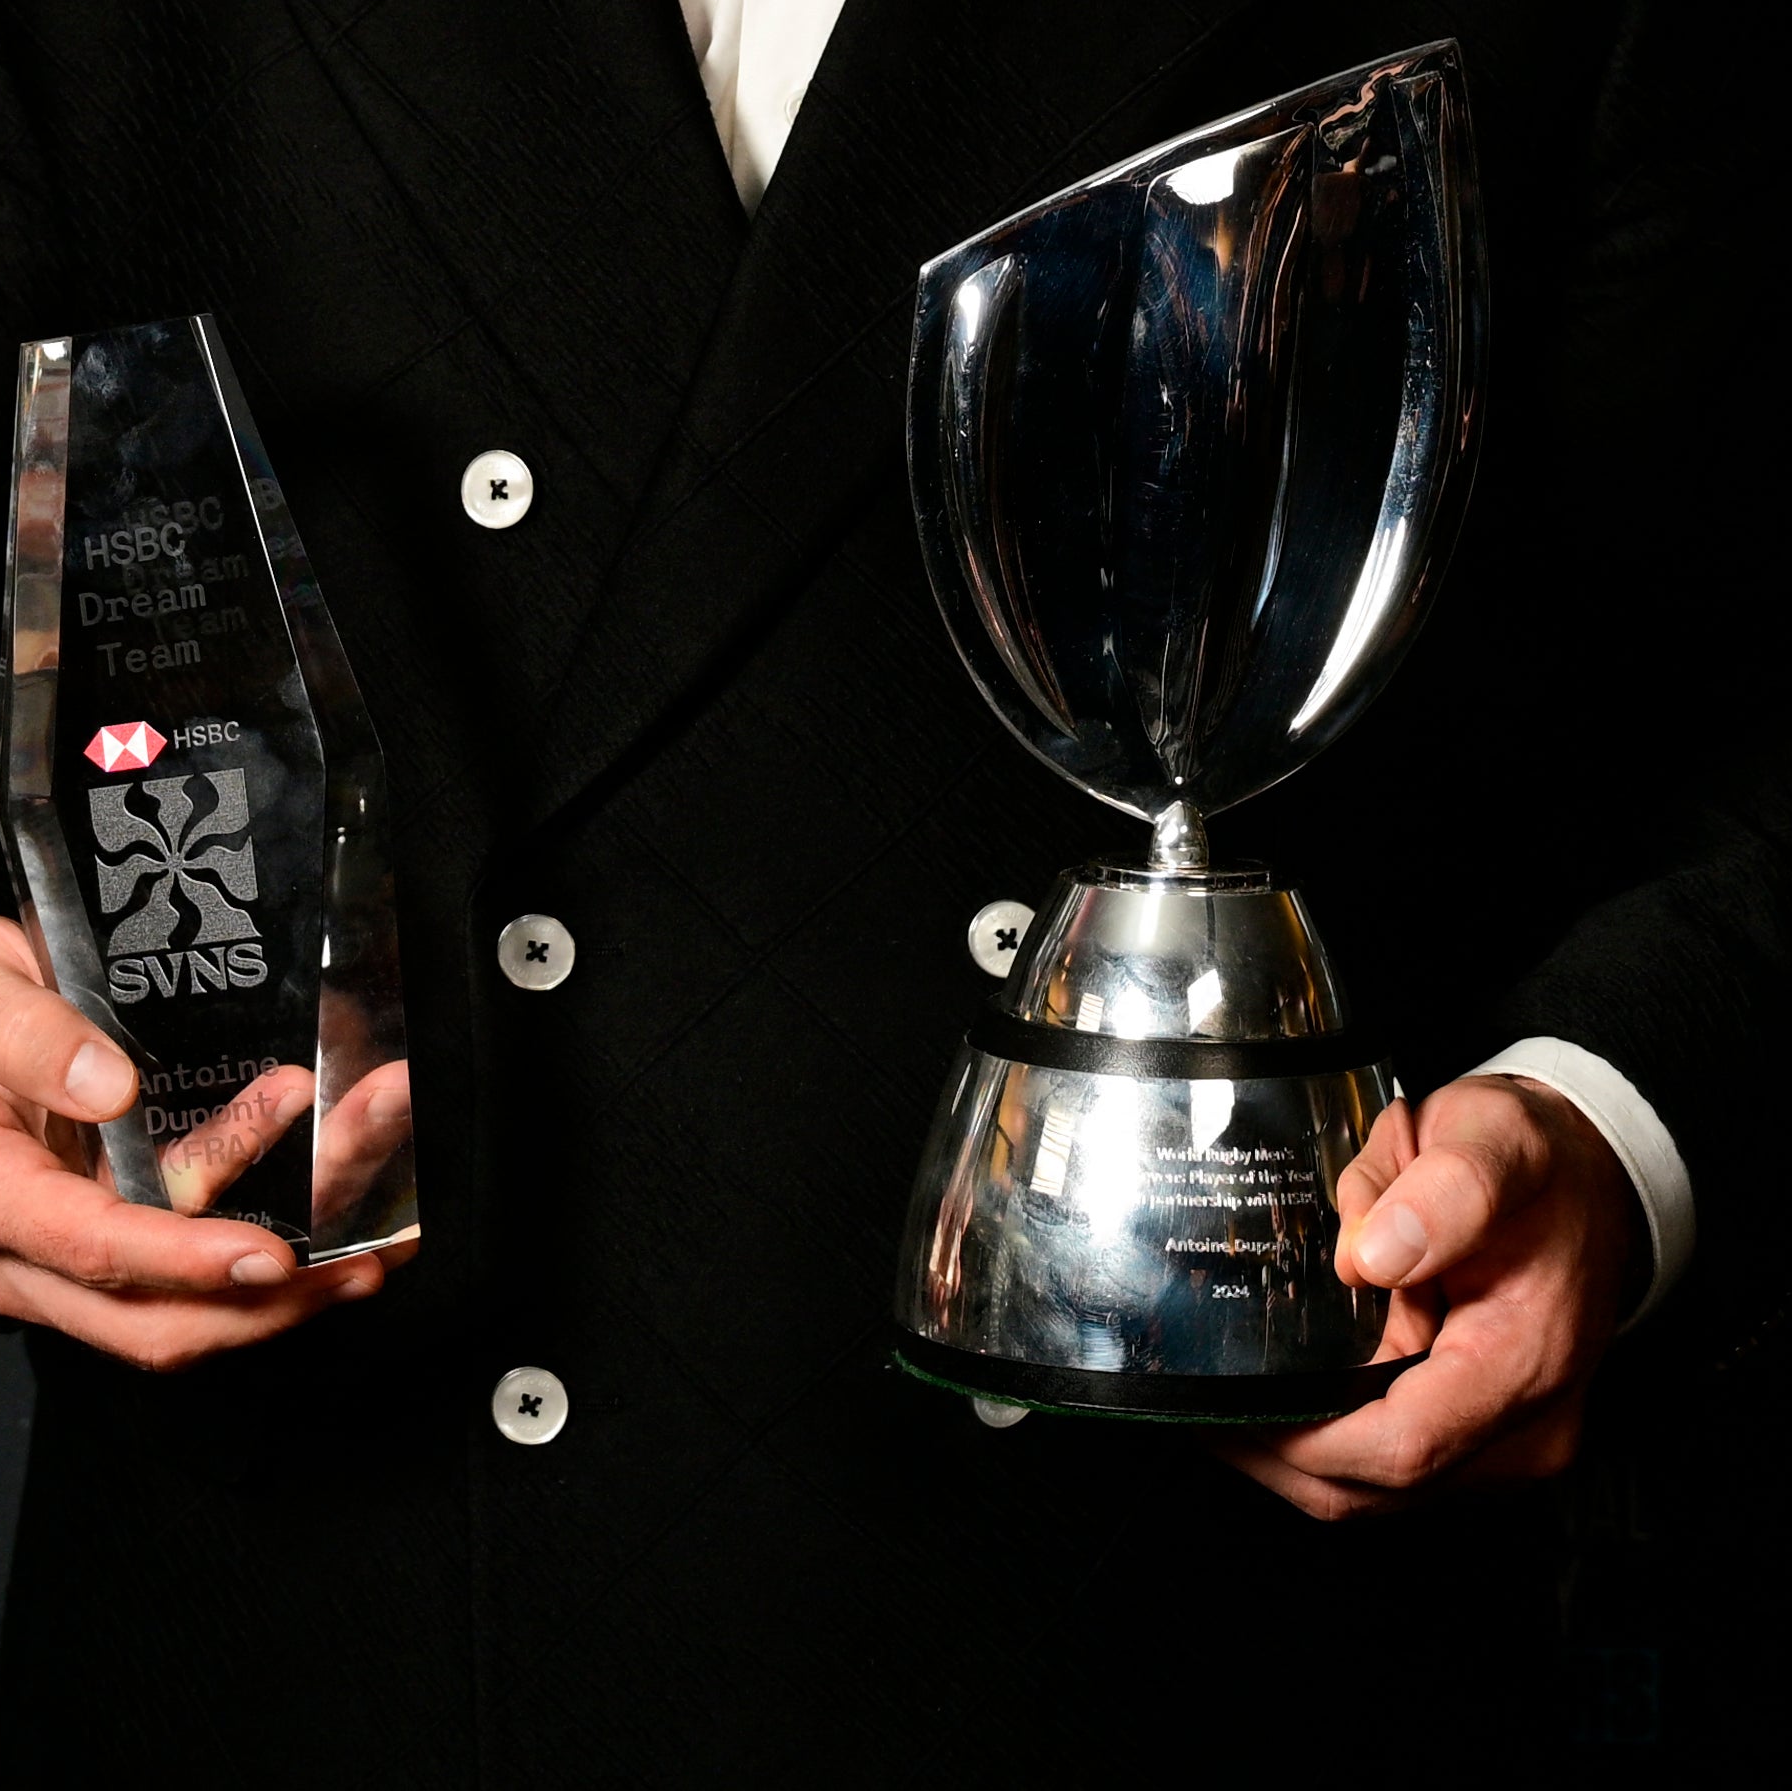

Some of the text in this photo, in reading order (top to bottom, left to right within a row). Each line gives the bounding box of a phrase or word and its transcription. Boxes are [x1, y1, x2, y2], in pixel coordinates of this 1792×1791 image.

[83, 521, 186, 571] HSBC
[78, 582, 208, 628] Dream
[96, 639, 202, 678] Team
[172, 720, 241, 751] HSBC
[108, 943, 269, 1005] SVNS
[136, 1054, 280, 1096] Antoine
[144, 1090, 275, 1136] Dupont
[1156, 1146, 1295, 1166] World Rugby Men's
[1189, 1168, 1237, 1188] Player
[1239, 1168, 1256, 1184] of
[1258, 1168, 1282, 1184] the
[1285, 1169, 1315, 1184] Year
[1245, 1191, 1278, 1206] with
[1164, 1237, 1294, 1255] Antoine Dupont
[1212, 1285, 1250, 1299] 2024
